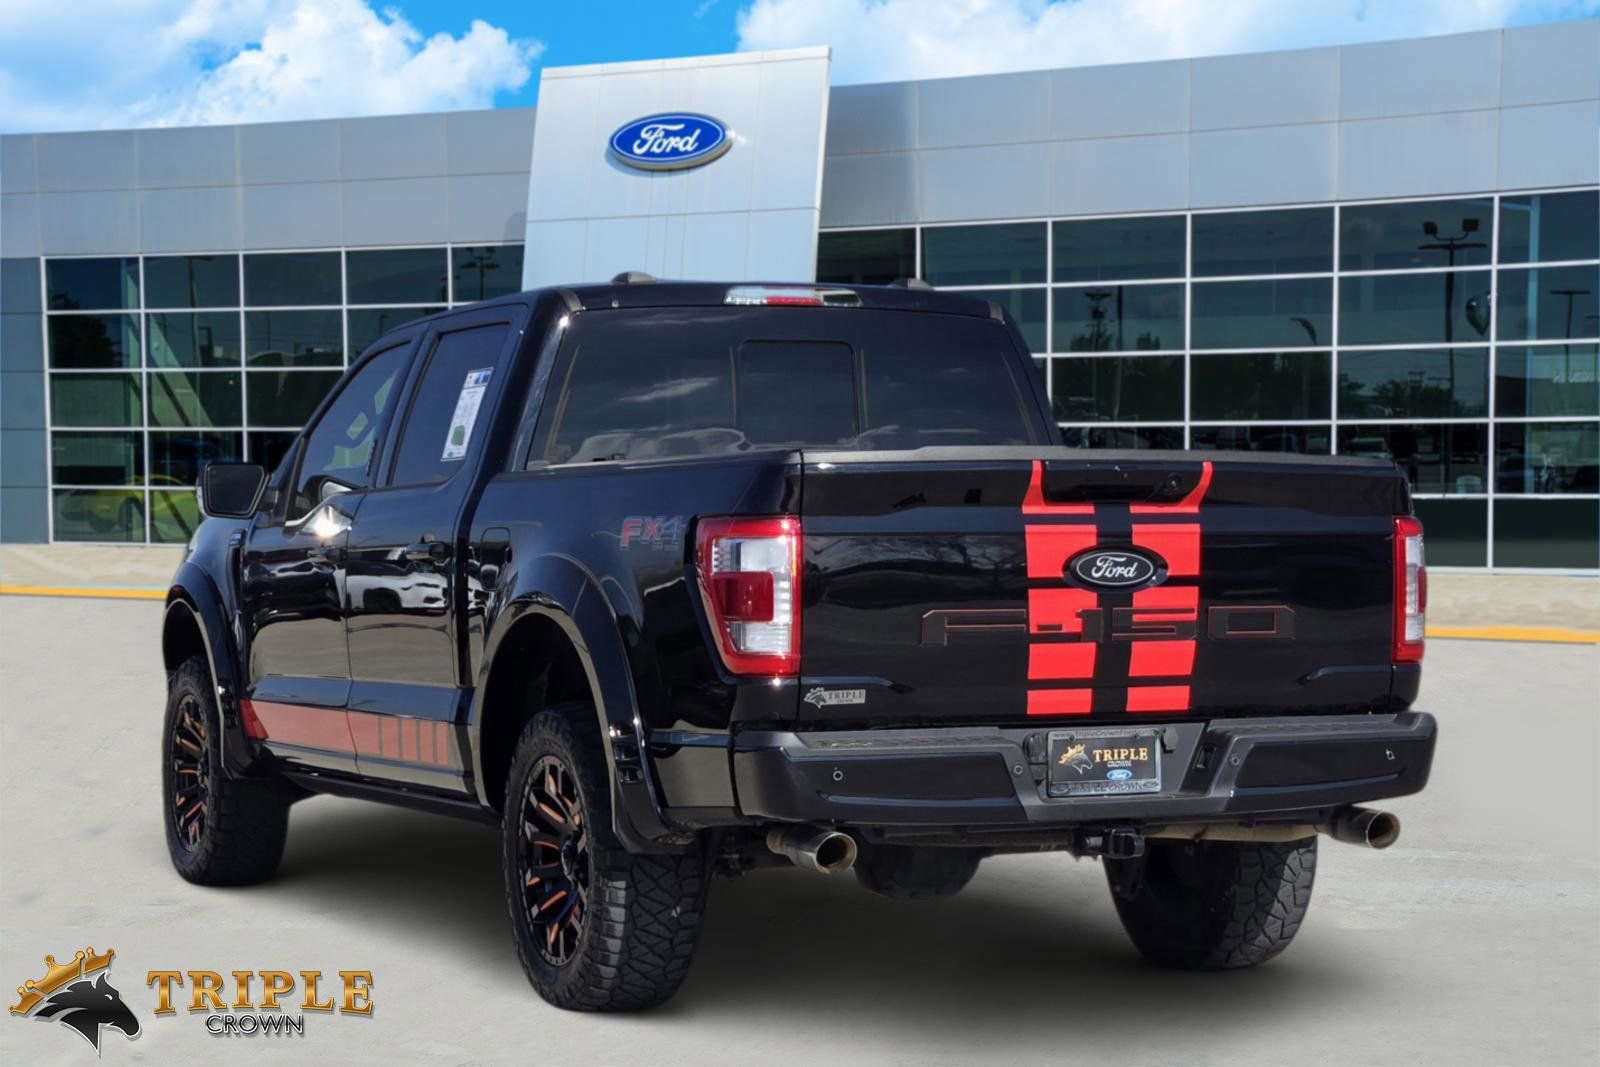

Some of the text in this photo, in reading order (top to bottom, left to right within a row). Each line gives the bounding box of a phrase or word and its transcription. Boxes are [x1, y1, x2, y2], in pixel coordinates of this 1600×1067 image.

[632, 123, 702, 155] Ford
[620, 516, 686, 549] FX4
[1091, 555, 1138, 578] Ford
[921, 604, 1296, 647] F-150
[827, 690, 865, 699] TRIPLE
[1092, 747, 1149, 763] TRIPLE
